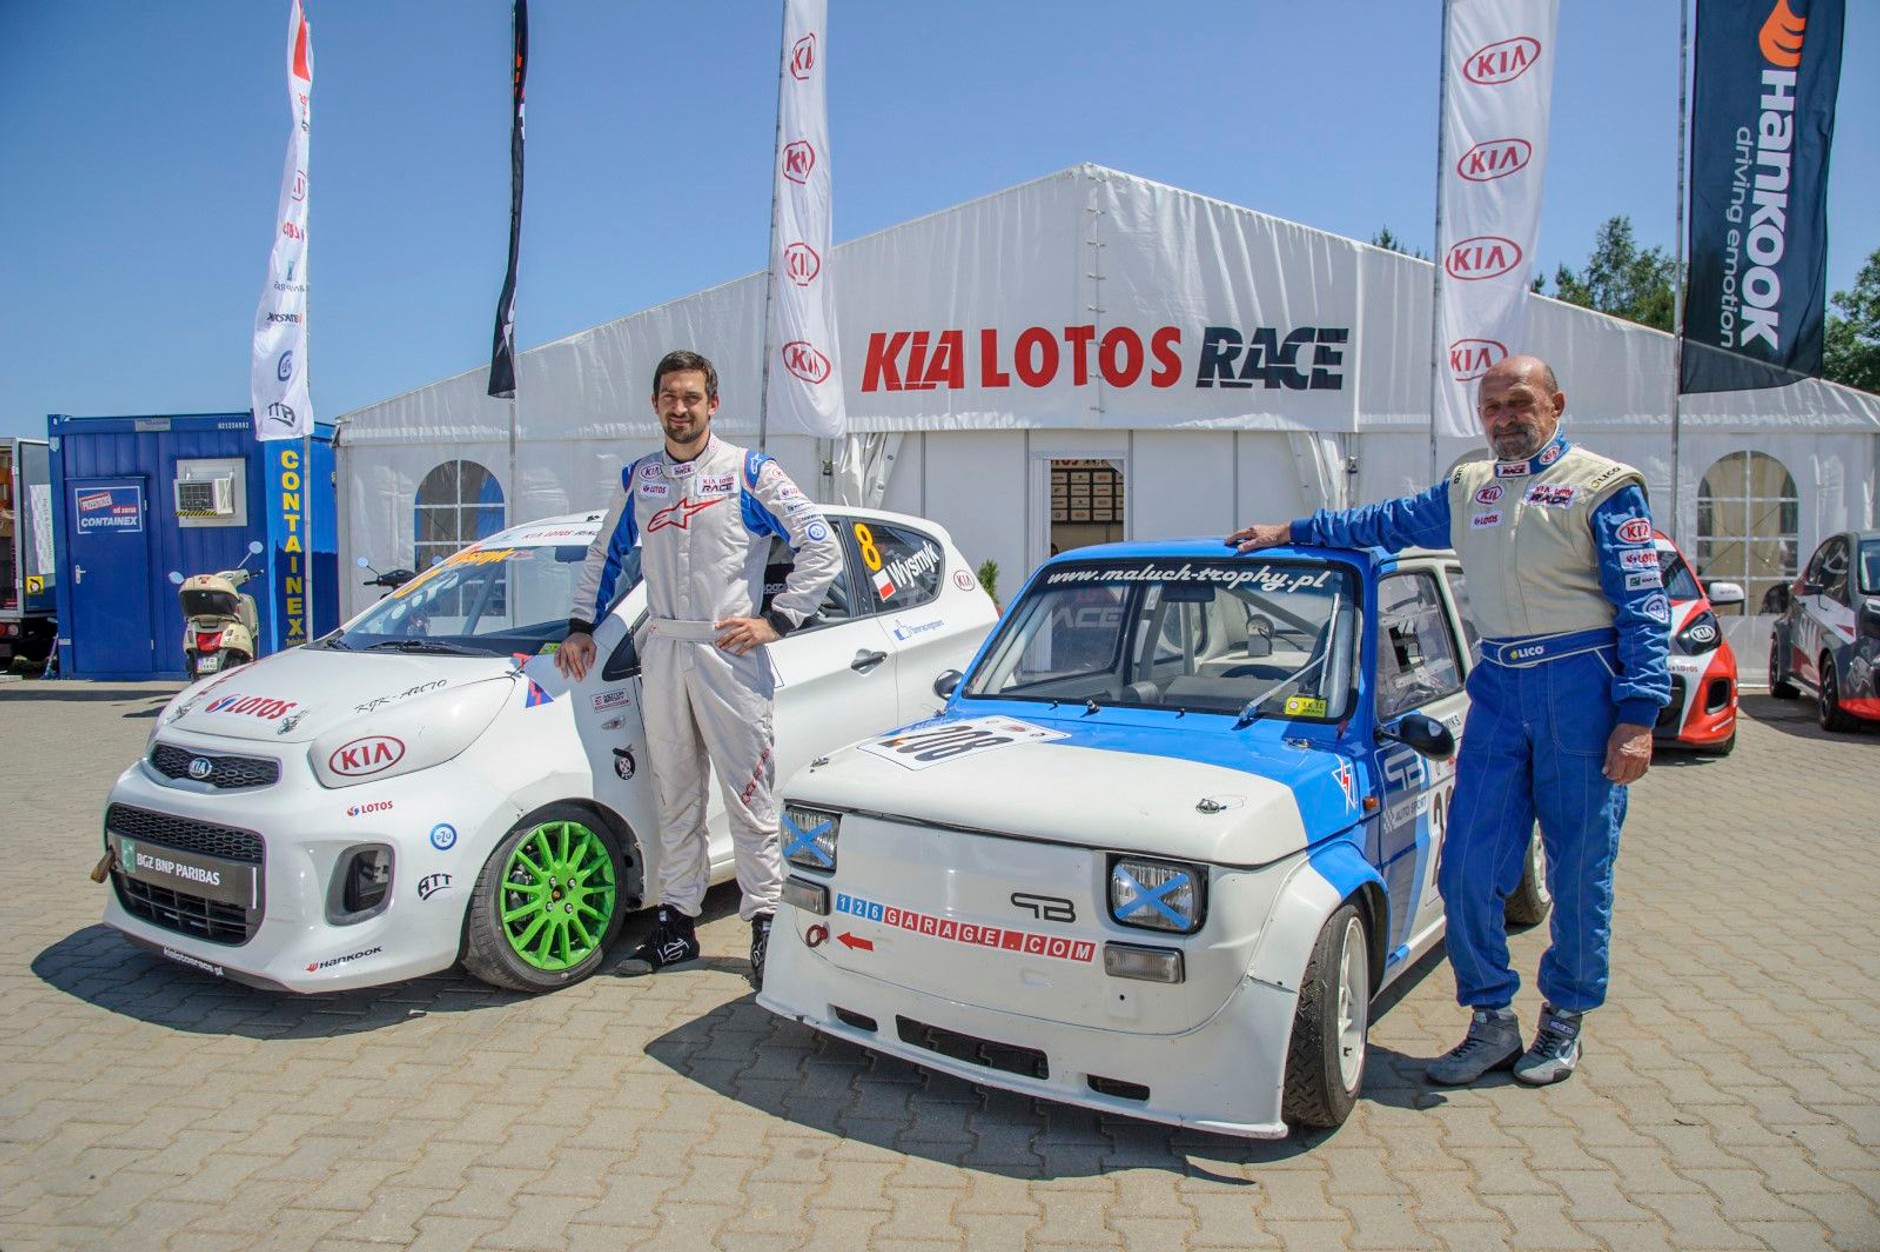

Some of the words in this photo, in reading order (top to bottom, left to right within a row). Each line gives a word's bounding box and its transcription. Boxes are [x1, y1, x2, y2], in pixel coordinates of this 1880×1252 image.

[1477, 46, 1528, 78] KIA
[1469, 146, 1519, 175] KIA
[1725, 126, 1753, 224] driving
[1453, 245, 1506, 274] KIA
[1719, 231, 1741, 348] emotion
[861, 329, 963, 392] KIA
[980, 325, 1182, 389] LOTOS
[1196, 326, 1349, 391] RACE
[1451, 347, 1492, 372] KIA
[645, 466, 660, 477] KIA
[1599, 466, 1621, 482] LICO
[649, 485, 667, 494] LOTOS
[702, 483, 733, 492] RACE
[1529, 493, 1570, 505] RACE
[81, 516, 138, 528] CONTAINEX
[280, 449, 305, 637] CONTAINEX
[854, 522, 882, 572] 8
[887, 540, 940, 588] Wysmyk
[957, 575, 974, 587] KIA
[1047, 563, 1332, 592] www.maluch-trophy.pl
[1694, 627, 1712, 640] KIA
[1518, 645, 1545, 658] LICO
[229, 695, 297, 720] LOTOS
[342, 742, 394, 771] KIA
[361, 800, 394, 814] LOTOS
[436, 830, 453, 844] PZU
[155, 857, 174, 874] BNP
[175, 862, 221, 886] PARIBAS
